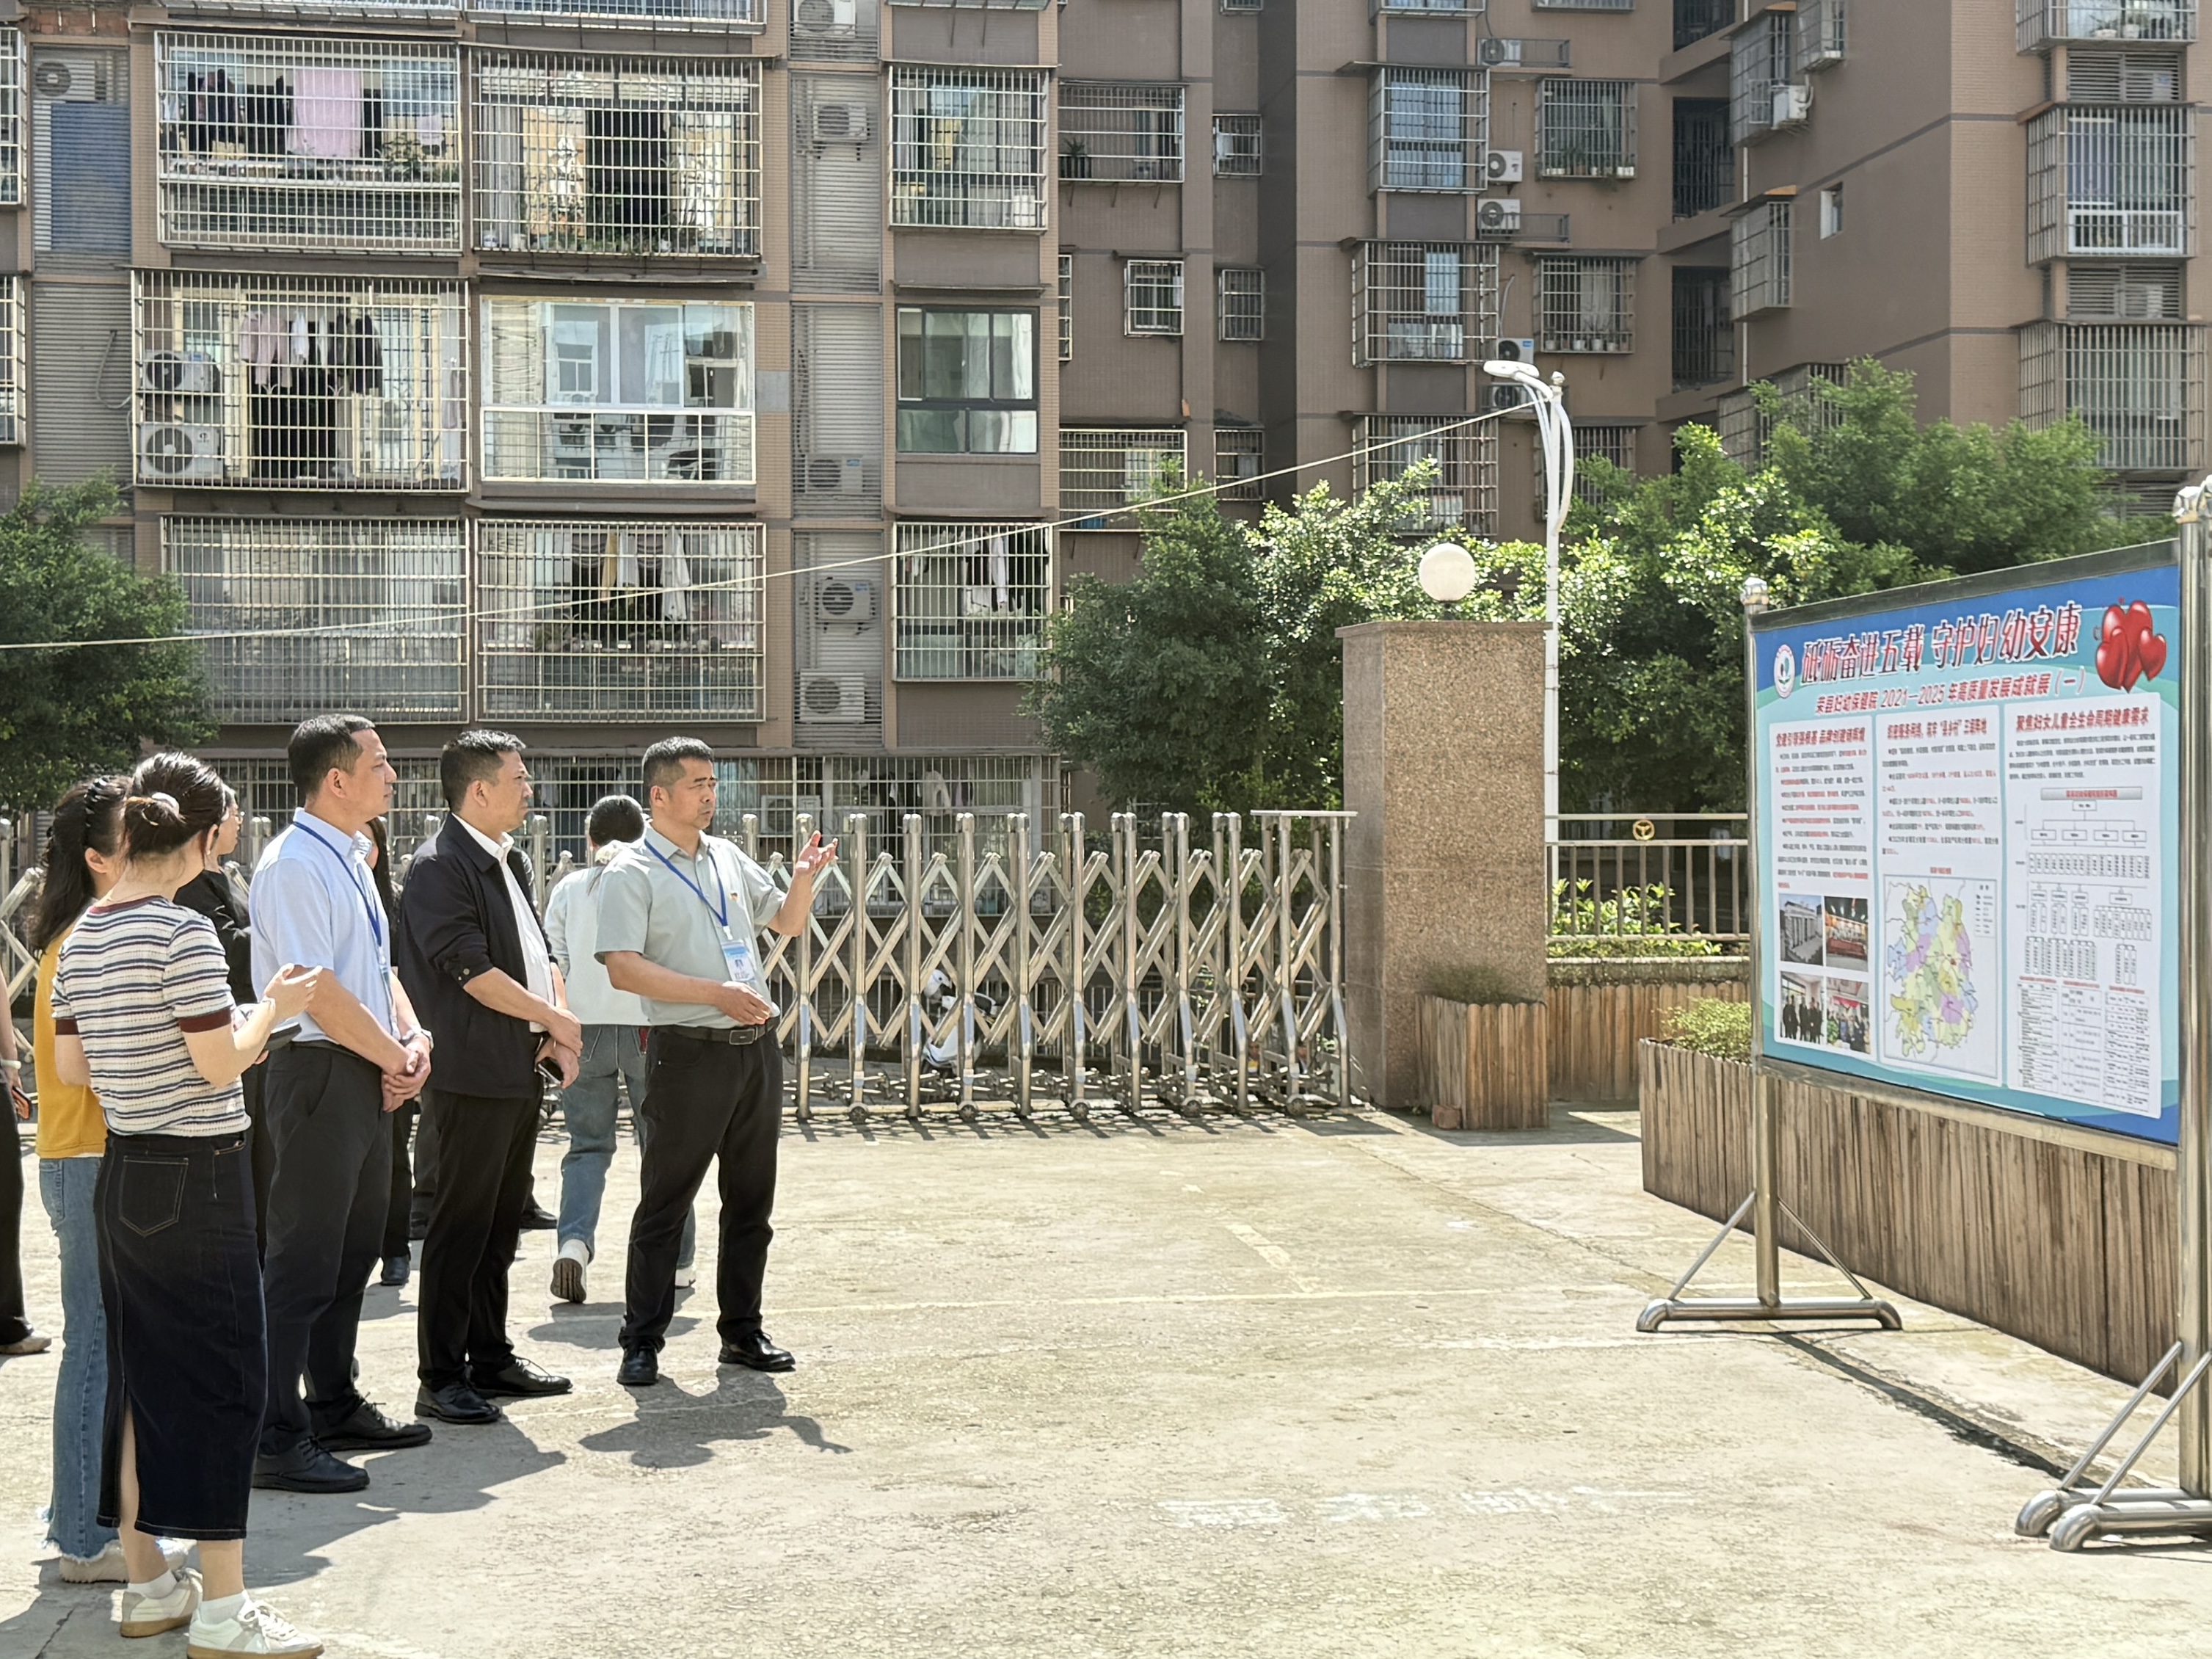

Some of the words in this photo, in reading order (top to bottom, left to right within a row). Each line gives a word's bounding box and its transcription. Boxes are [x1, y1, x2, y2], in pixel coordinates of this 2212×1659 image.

[1801, 625, 1925, 686] 砥砺奋进五载
[1932, 600, 2082, 669] 守护妇幼安康
